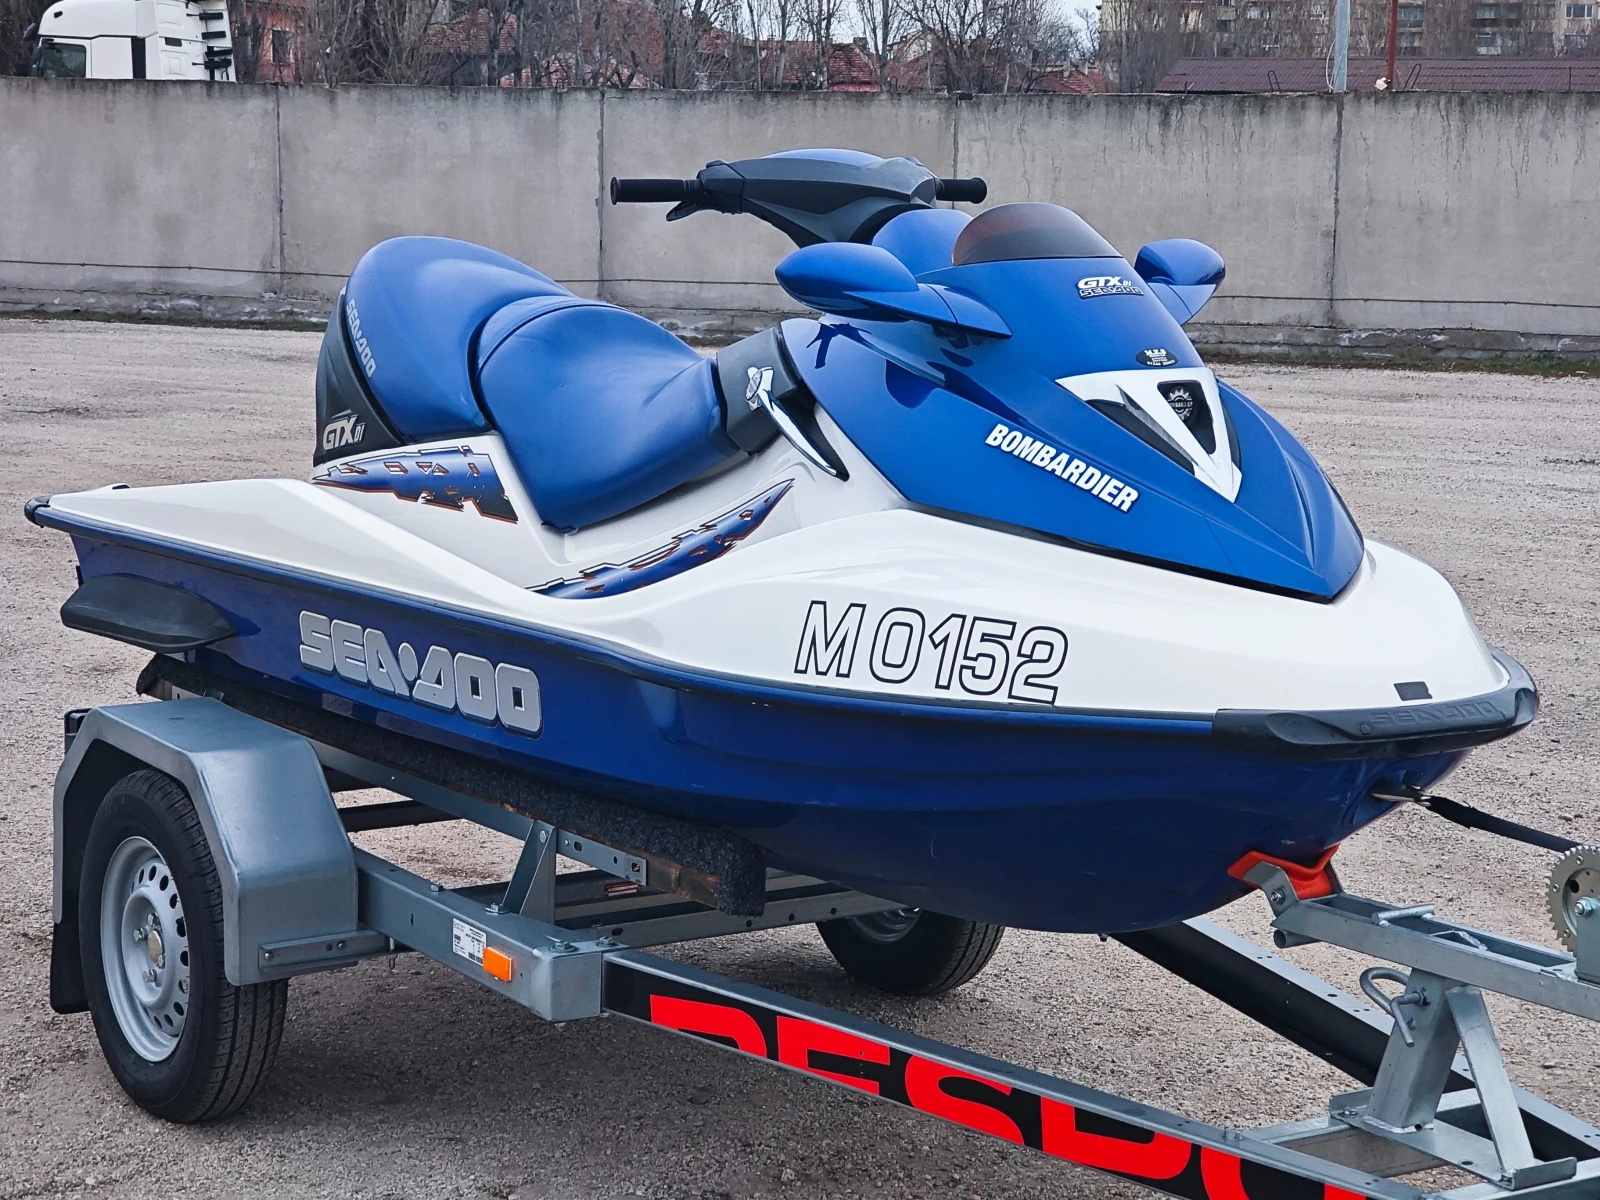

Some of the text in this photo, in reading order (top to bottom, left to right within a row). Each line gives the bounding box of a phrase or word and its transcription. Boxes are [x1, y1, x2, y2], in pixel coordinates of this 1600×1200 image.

[1077, 276, 1122, 289] GTX
[322, 416, 358, 450] GTX
[984, 423, 1139, 512] BOMBARDIER
